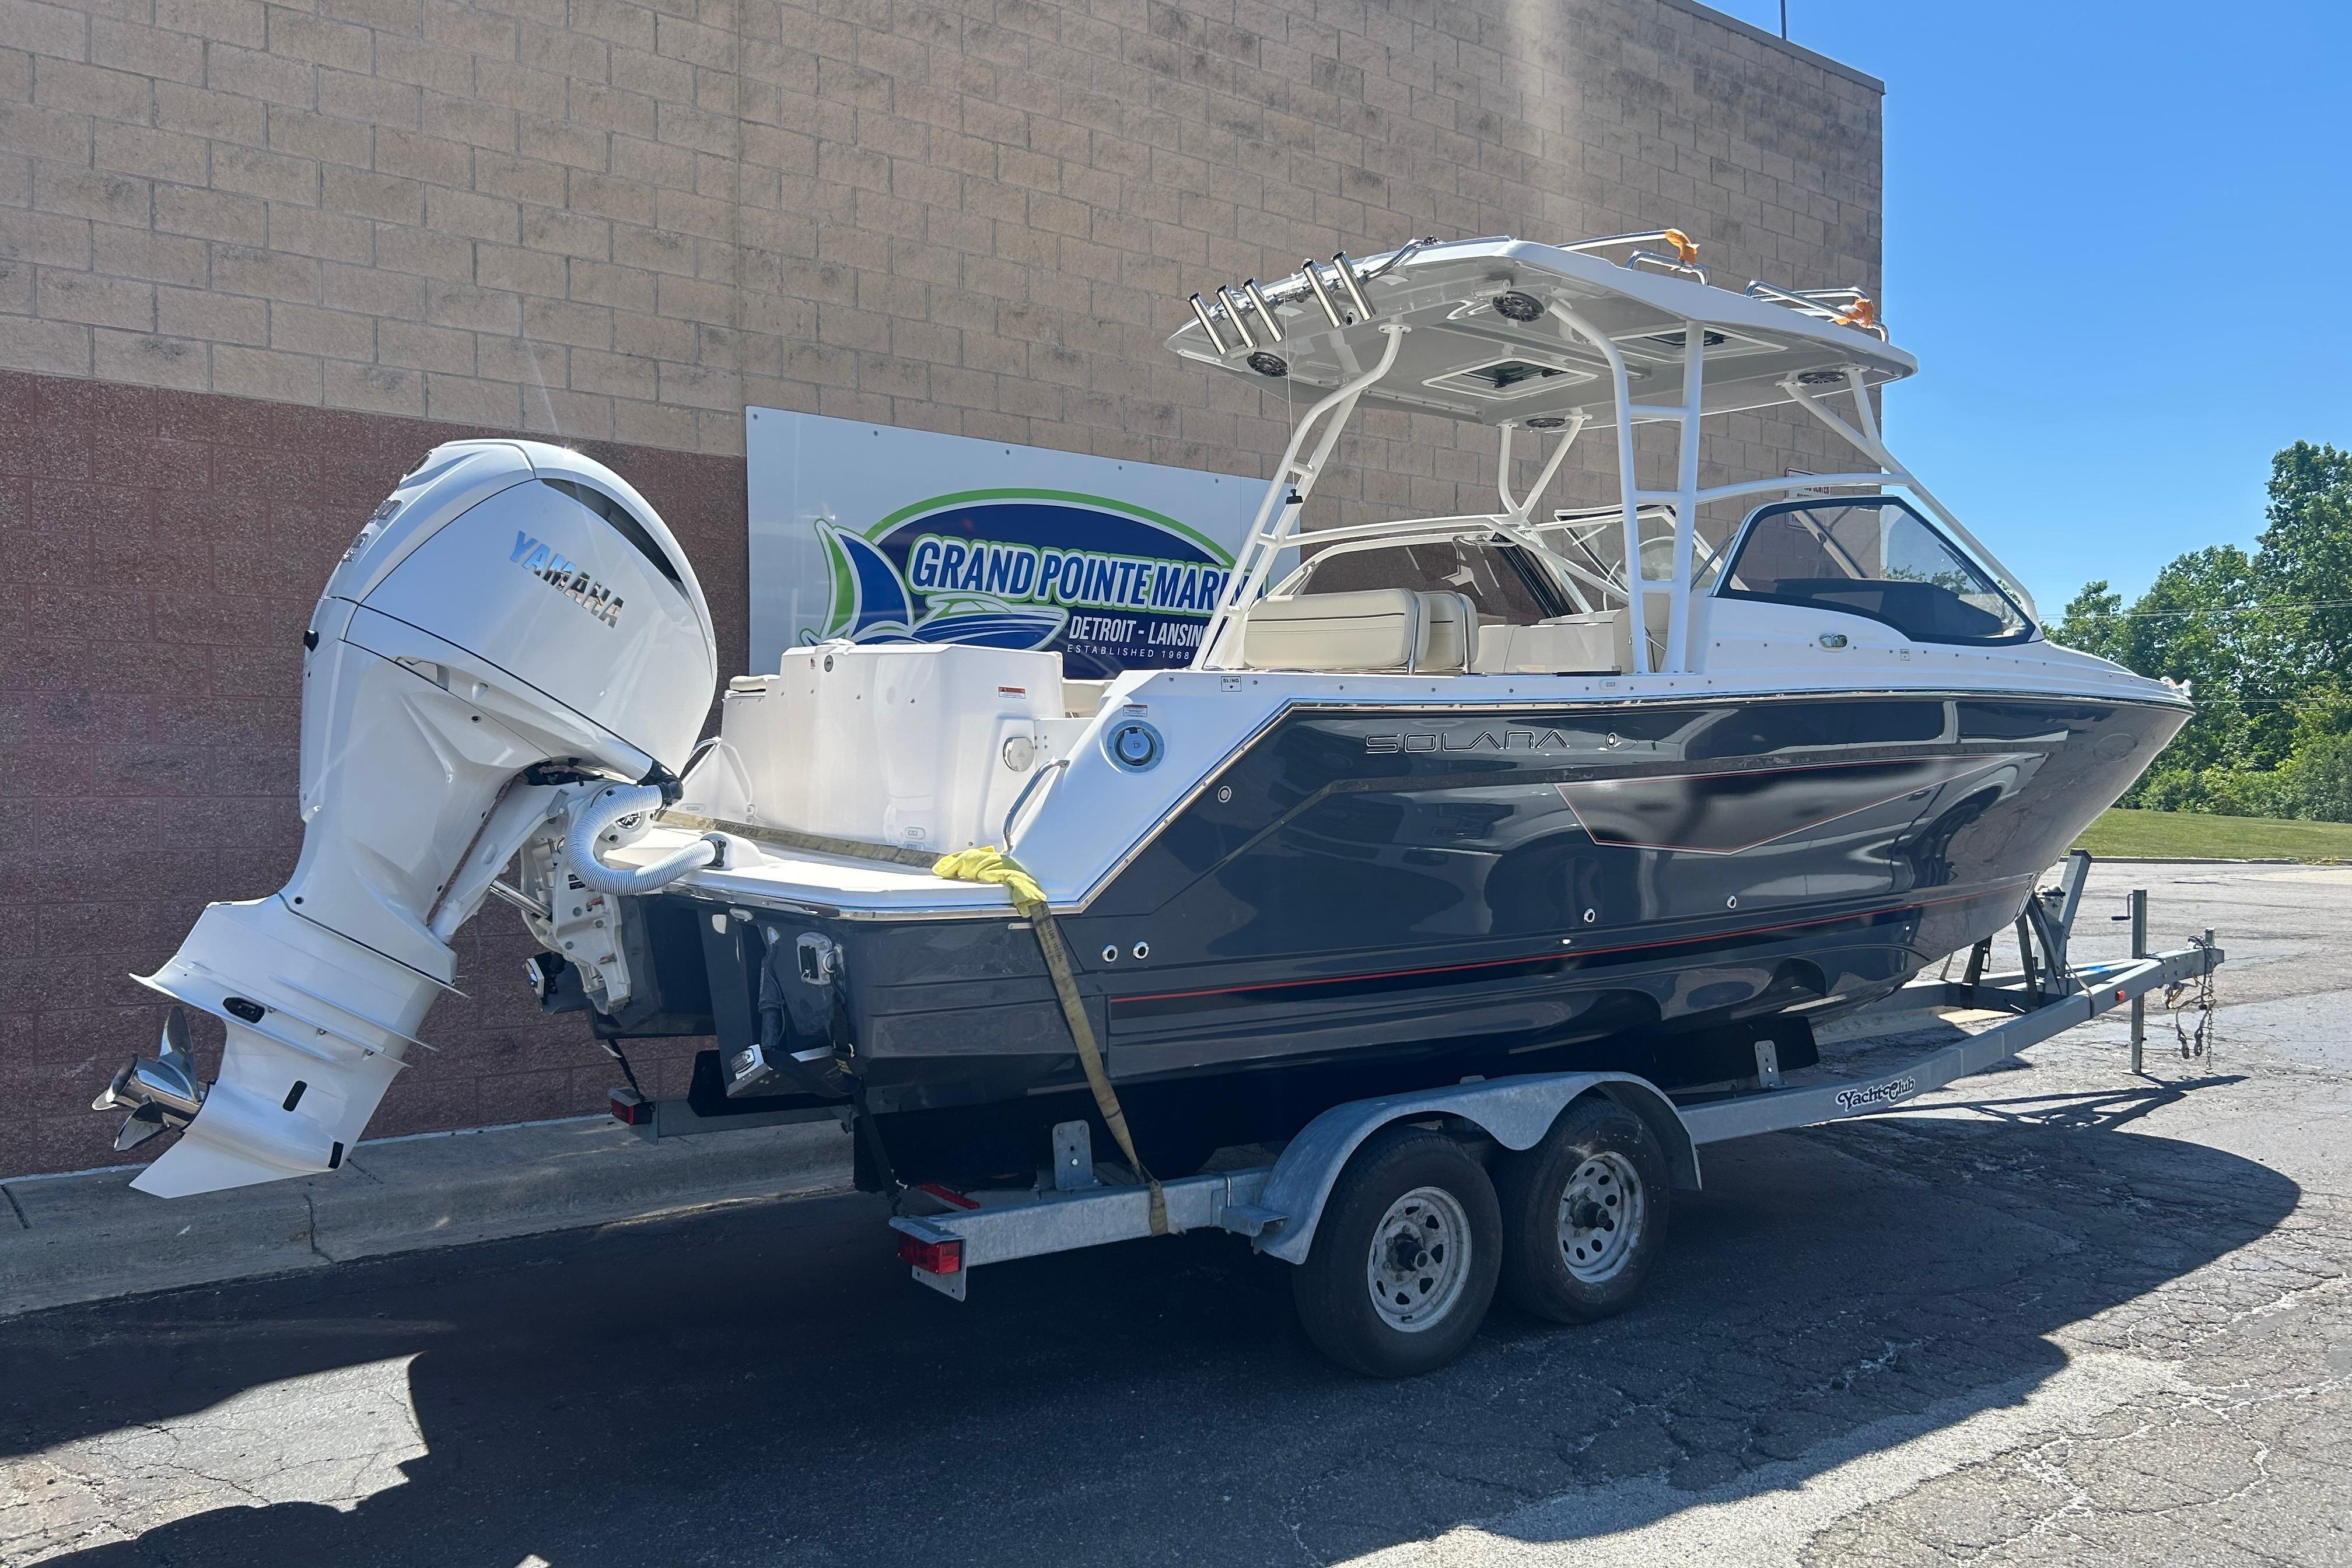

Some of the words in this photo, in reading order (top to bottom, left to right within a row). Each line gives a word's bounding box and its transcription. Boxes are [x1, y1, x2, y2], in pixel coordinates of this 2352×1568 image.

[510, 530, 624, 629] YAMAHA
[912, 541, 1036, 594] GRAND
[1037, 554, 1152, 605] POINTE
[1069, 615, 1137, 643] DETROIT
[1067, 644, 1154, 657] ESTABLISHED
[1161, 650, 1189, 660] 1968
[1365, 729, 1570, 754] SOLARA
[734, 825, 761, 837] CONTROL
